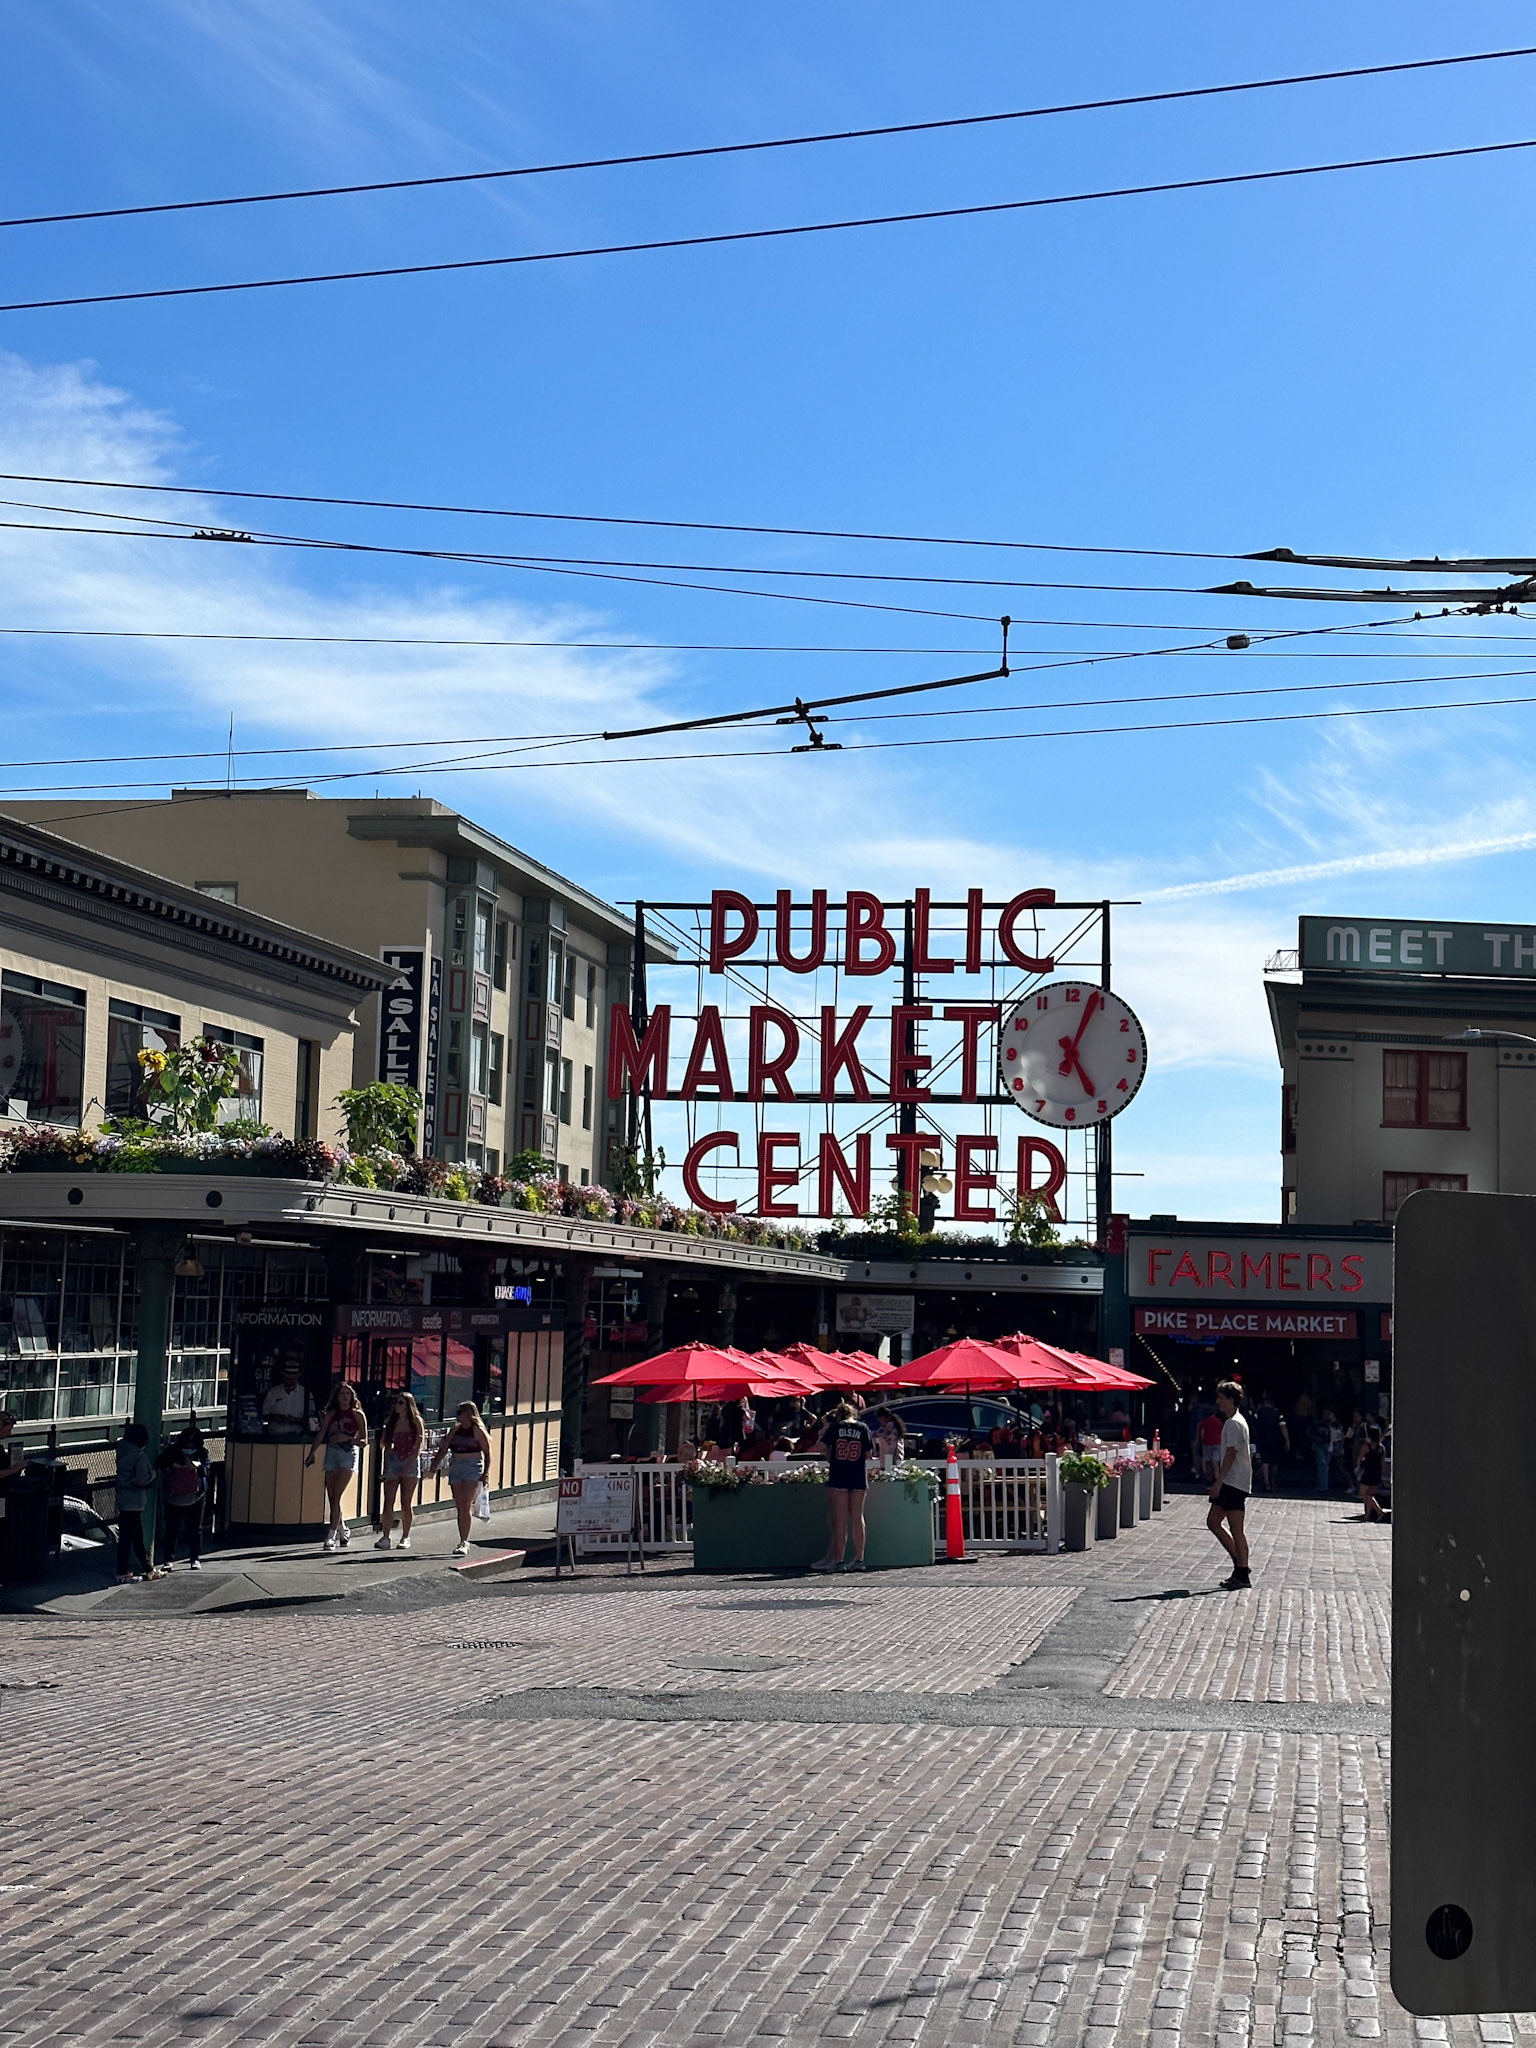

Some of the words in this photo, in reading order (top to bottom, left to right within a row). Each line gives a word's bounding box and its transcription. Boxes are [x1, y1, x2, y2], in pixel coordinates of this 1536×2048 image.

[709, 888, 1056, 975] PUBLIC
[1327, 926, 1453, 965] MEET
[388, 956, 414, 991] LA
[430, 960, 440, 996] LA
[1066, 988, 1081, 1002] 12
[1037, 996, 1048, 1010] 11
[1015, 1018, 1028, 1031] 10
[1119, 1019, 1129, 1032] 2
[385, 998, 414, 1087] SALLE
[427, 1006, 439, 1094] SALLE
[607, 1004, 1000, 1102] MARKET
[1006, 1048, 1017, 1061] 9
[1127, 1048, 1136, 1063] 3
[1013, 1077, 1023, 1091] 8
[1116, 1078, 1128, 1092] 4
[1036, 1100, 1046, 1112] 7
[1097, 1100, 1107, 1113] 5
[1065, 1108, 1075, 1121] 6
[682, 1131, 1067, 1223] CENTER
[1148, 1249, 1365, 1292] FARMERS
[495, 1285, 514, 1300] CHASE
[238, 1313, 322, 1325] NFORMATION
[352, 1310, 403, 1327] INFORMATION
[422, 1312, 442, 1329] seattle
[1144, 1312, 1188, 1329] PIKE
[1196, 1313, 1259, 1331] PLACE
[1266, 1315, 1347, 1333] MARKET
[836, 1439, 861, 1461] 28
[562, 1481, 579, 1496] NO
